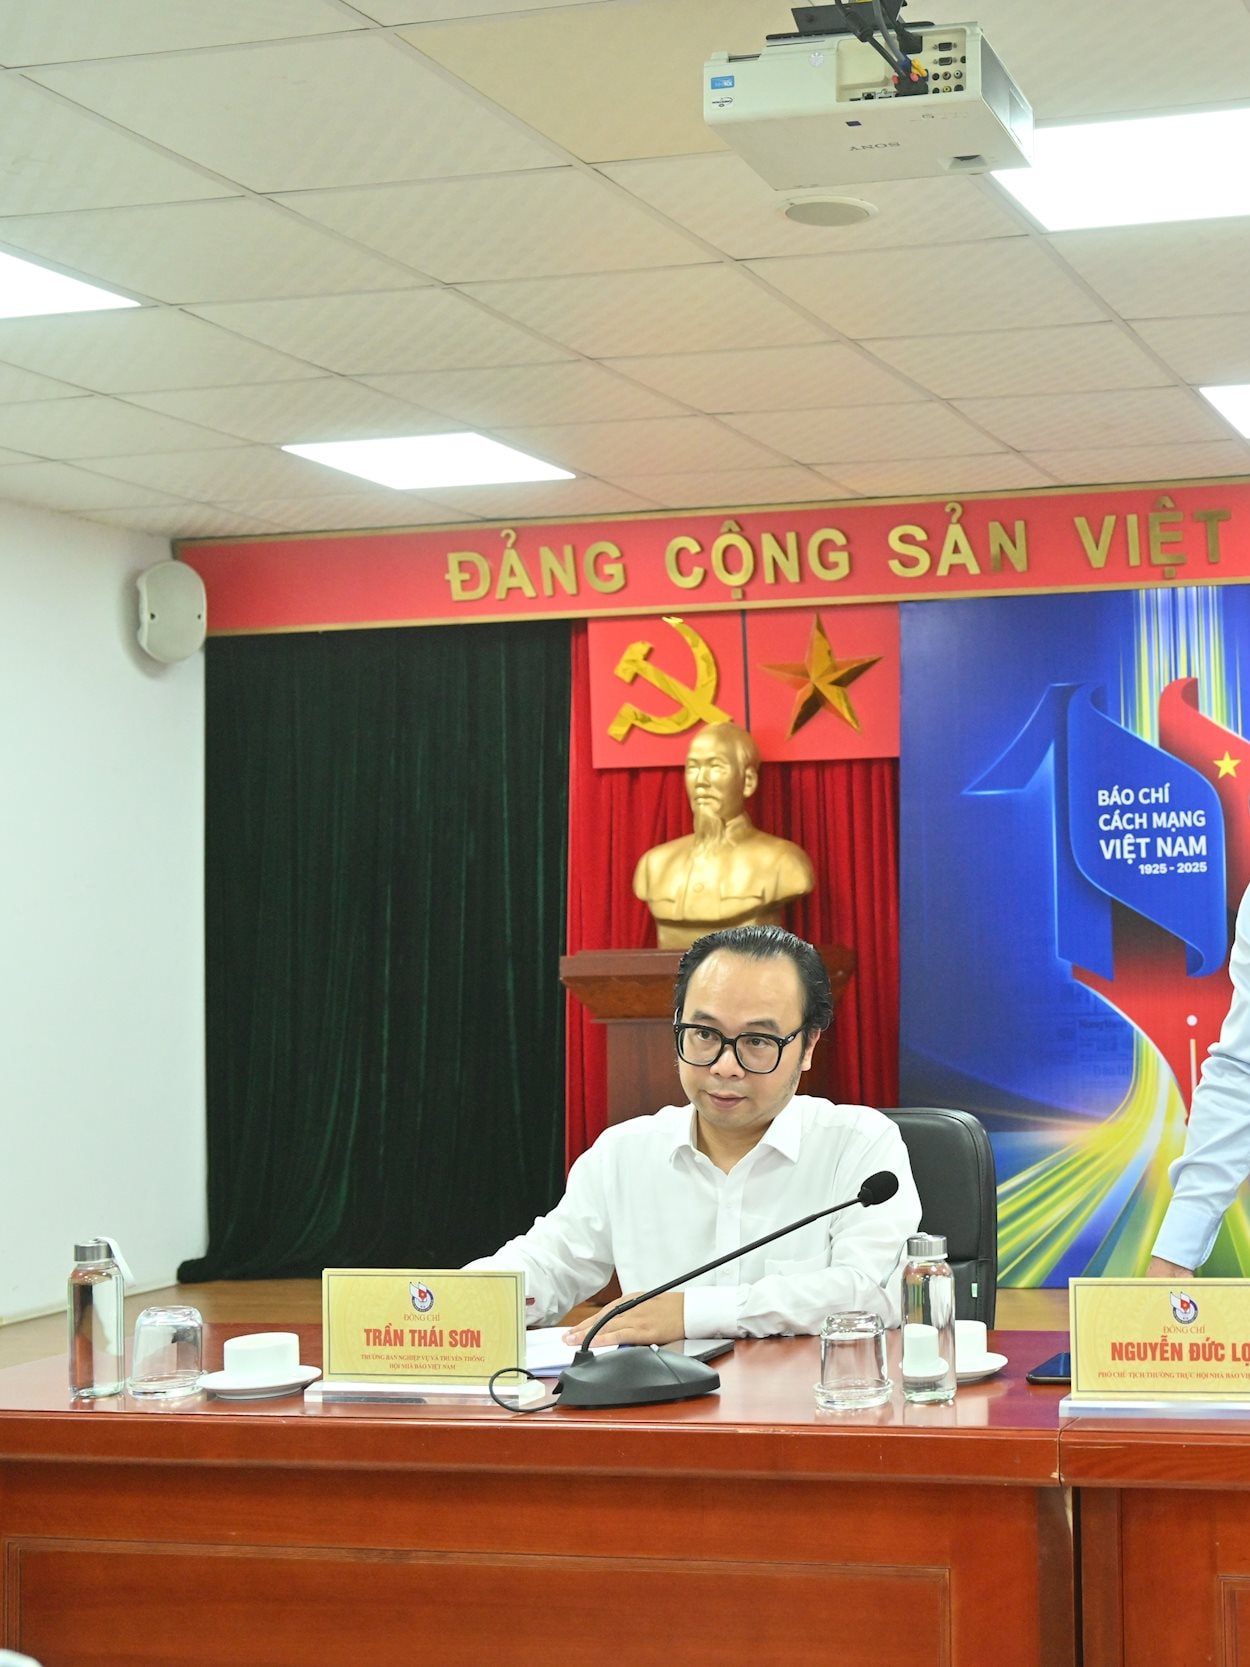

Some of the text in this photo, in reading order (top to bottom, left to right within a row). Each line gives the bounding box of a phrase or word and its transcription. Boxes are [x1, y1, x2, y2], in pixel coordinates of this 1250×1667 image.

[850, 142, 901, 152] SONY
[444, 528, 626, 602] ĐẢNG
[665, 519, 851, 600] CỘNG
[888, 501, 1028, 578] SẢN
[1073, 496, 1231, 579] VIỆT
[1097, 782, 1171, 807] BÁO CHÍ
[1098, 808, 1207, 833] CÁCH MẠNG
[1098, 834, 1208, 865] VIỆT NAM
[1138, 863, 1168, 875] 1925
[1176, 861, 1208, 874] 2025
[364, 1322, 481, 1349] TRẦN THÁI SƠN
[1111, 1336, 1183, 1362] NGUYỄN
[1189, 1337, 1226, 1362] ĐỨC
